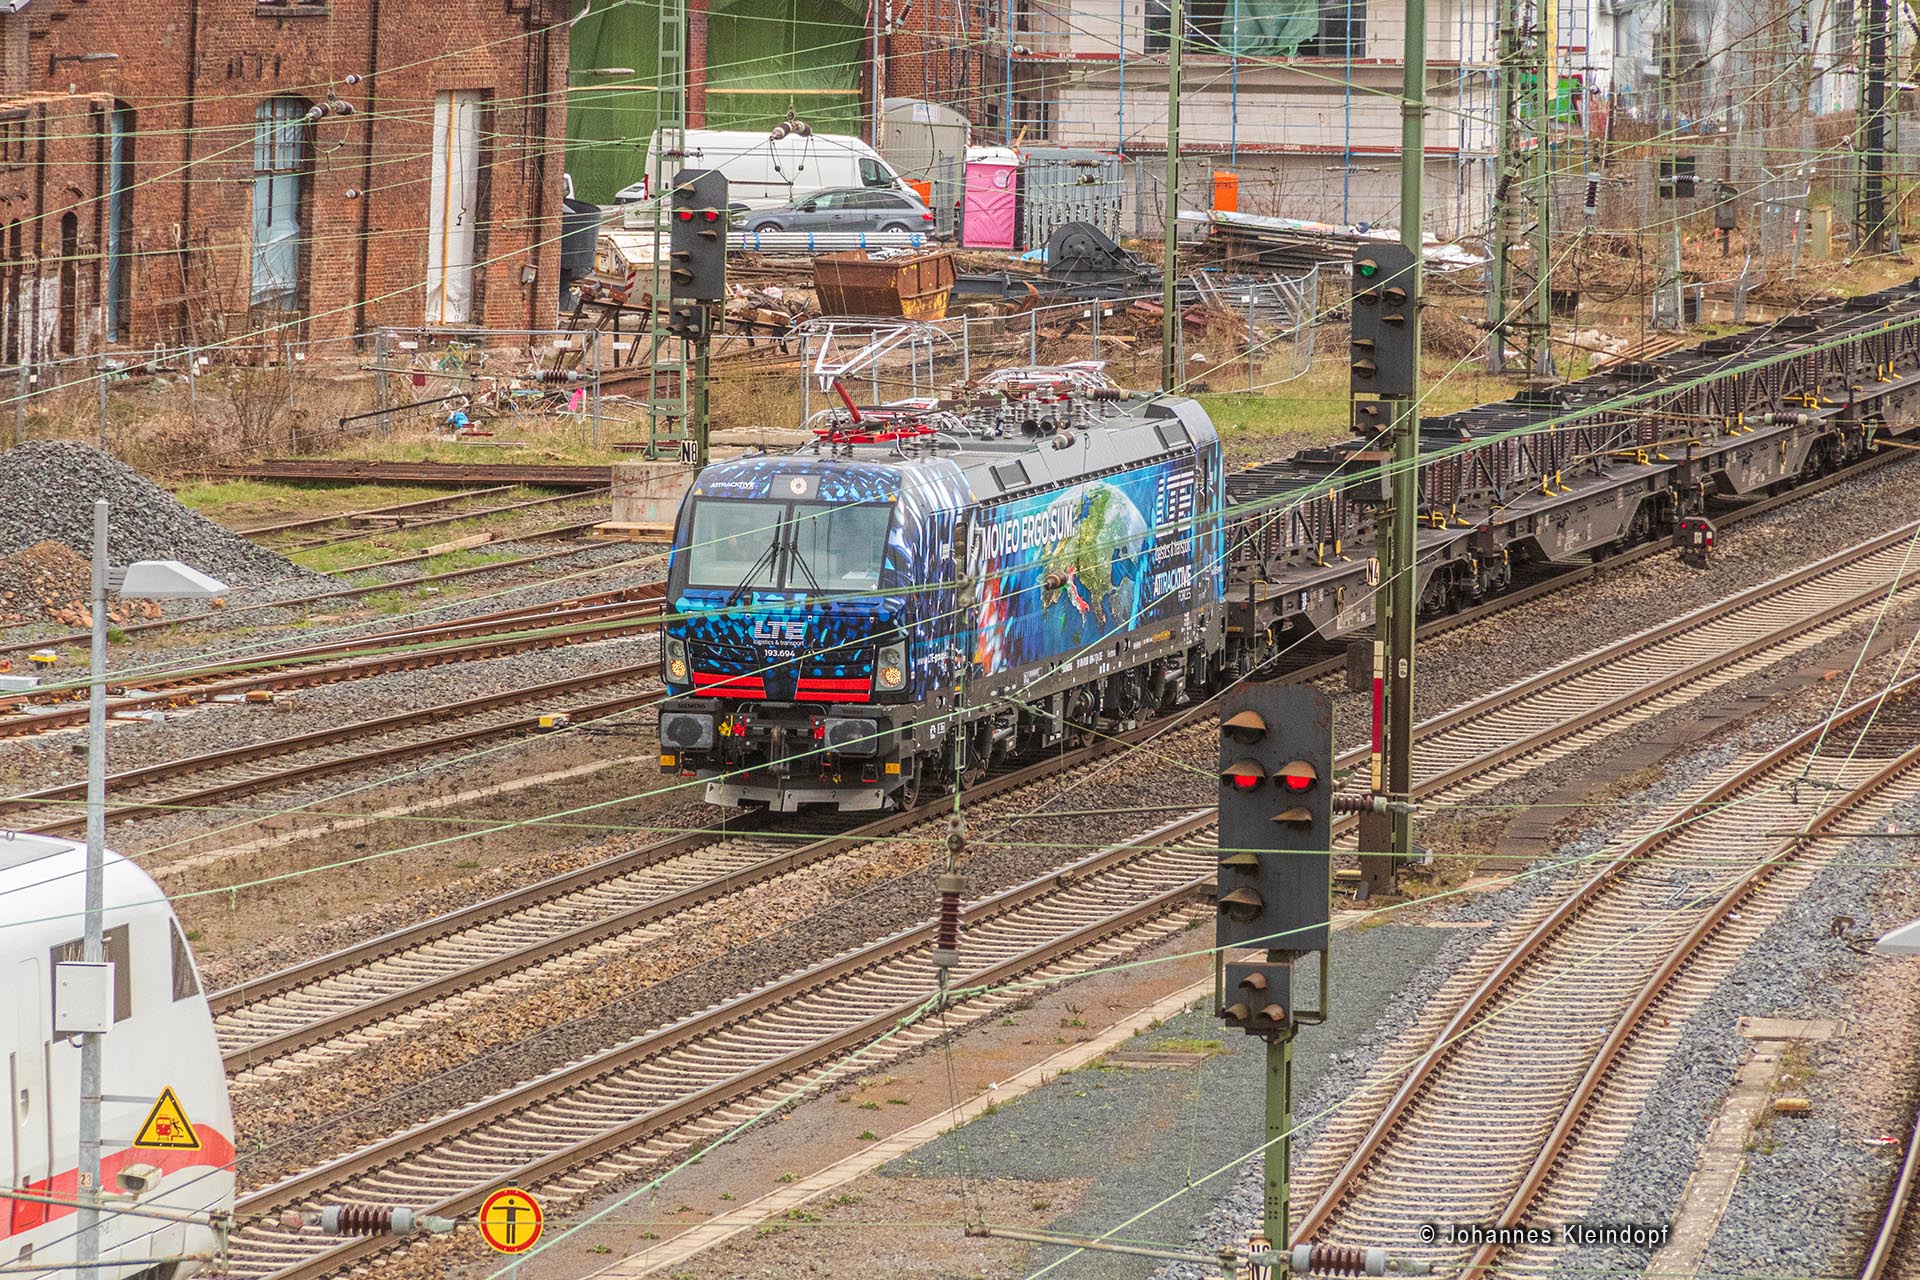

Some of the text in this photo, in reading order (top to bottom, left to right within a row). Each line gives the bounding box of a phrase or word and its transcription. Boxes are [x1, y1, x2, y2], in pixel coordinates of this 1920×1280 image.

[682, 442, 697, 462] N8
[1156, 471, 1194, 538] LTE
[982, 504, 1075, 560] MOVEO ERGO SUM.
[1367, 560, 1379, 583] N4
[754, 620, 806, 640] LTE
[764, 649, 796, 657] 193.694
